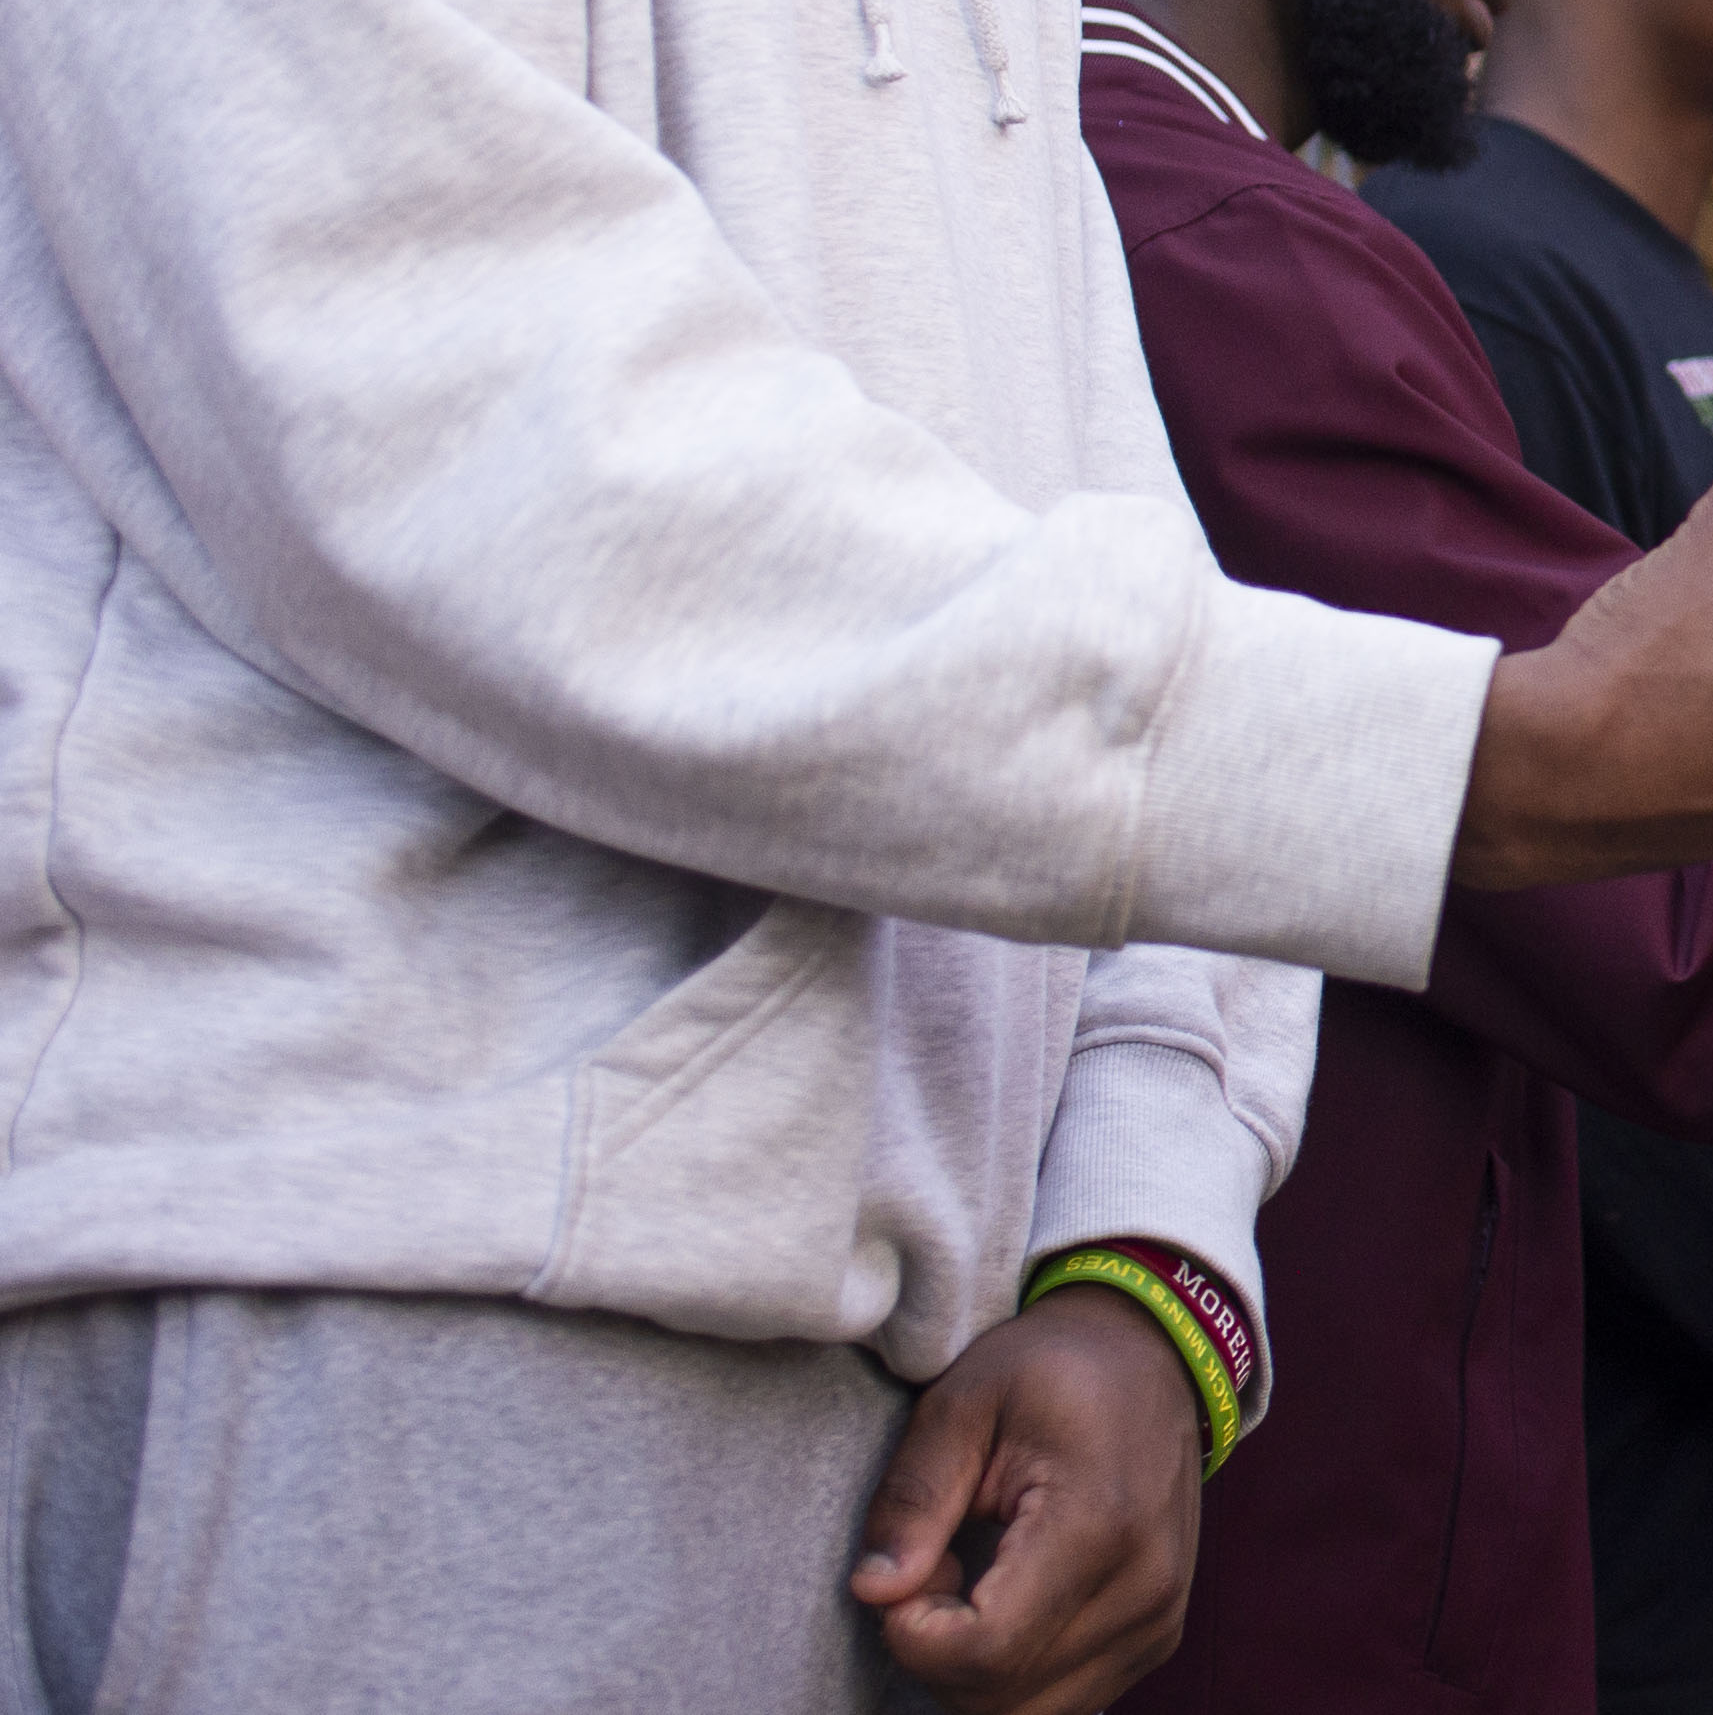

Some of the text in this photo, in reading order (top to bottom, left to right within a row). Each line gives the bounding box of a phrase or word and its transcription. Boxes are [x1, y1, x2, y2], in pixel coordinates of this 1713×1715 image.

[1065, 1255, 1236, 1447] BLACK MEN'S LIVES
